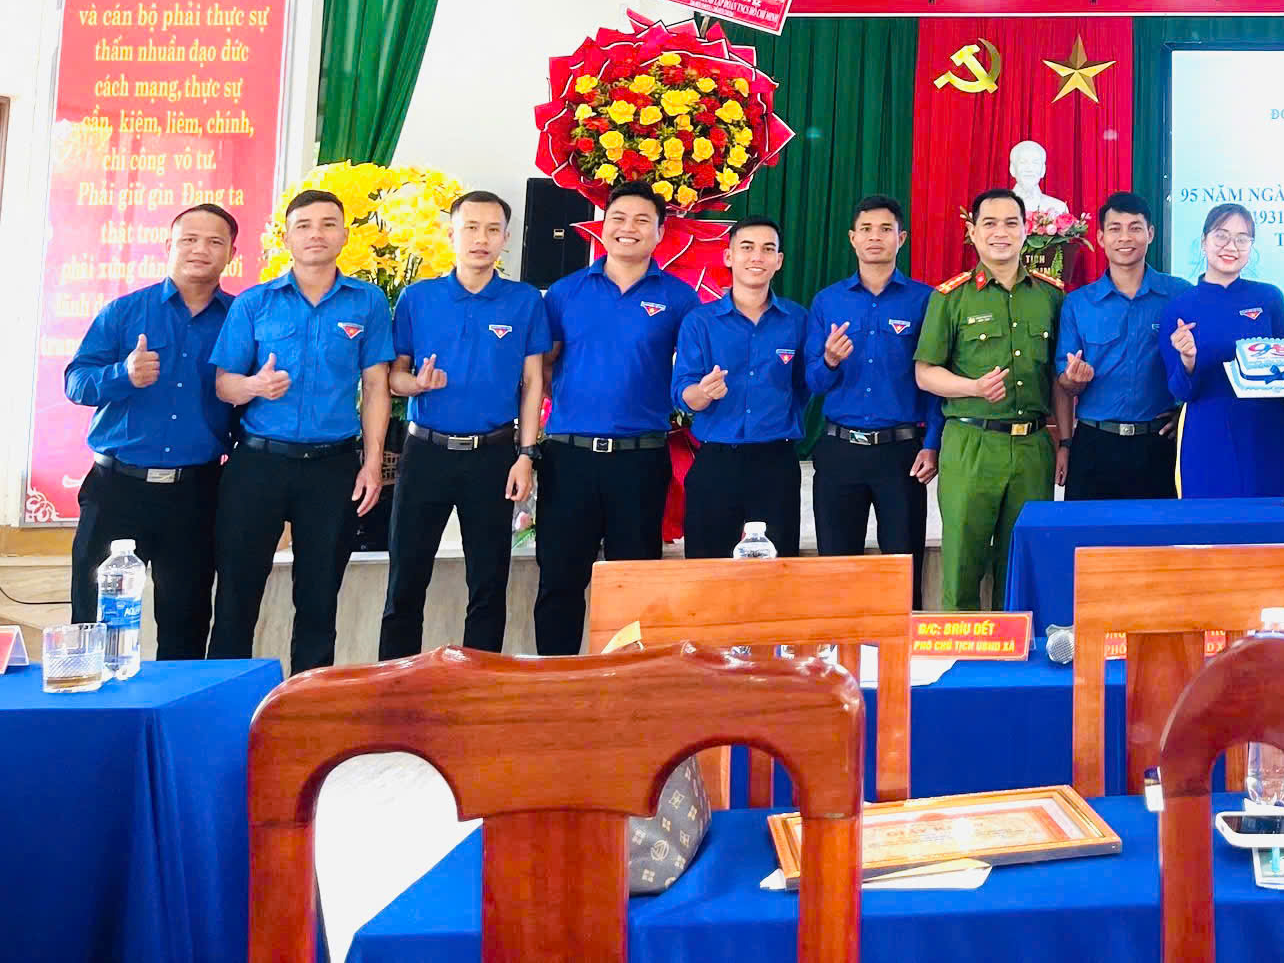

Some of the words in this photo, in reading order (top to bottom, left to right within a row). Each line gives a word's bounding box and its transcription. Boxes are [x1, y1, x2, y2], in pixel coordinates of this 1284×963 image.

[79, 4, 97, 27] và
[103, 4, 132, 27] cán
[137, 3, 158, 32] bộ
[162, 1, 201, 32] phải
[207, 3, 244, 32] thực
[248, 5, 271, 32] sự
[95, 36, 133, 62] thấm
[189, 39, 217, 67] đạo
[221, 38, 249, 62] đức
[95, 74, 129, 98] cách
[135, 79, 182, 104] mạng,
[184, 75, 221, 104] thực
[224, 77, 244, 104] sự
[119, 109, 161, 139] kiệm,
[166, 110, 202, 135] liêm,
[207, 110, 254, 136] chính,
[130, 150, 165, 175] công
[174, 147, 191, 170] vô
[77, 181, 114, 206] Phải
[117, 181, 147, 211] giữ
[181, 181, 225, 207] Đảng
[229, 185, 244, 206] ta
[1181, 188, 1198, 202] 95
[1202, 184, 1243, 202] NĂM
